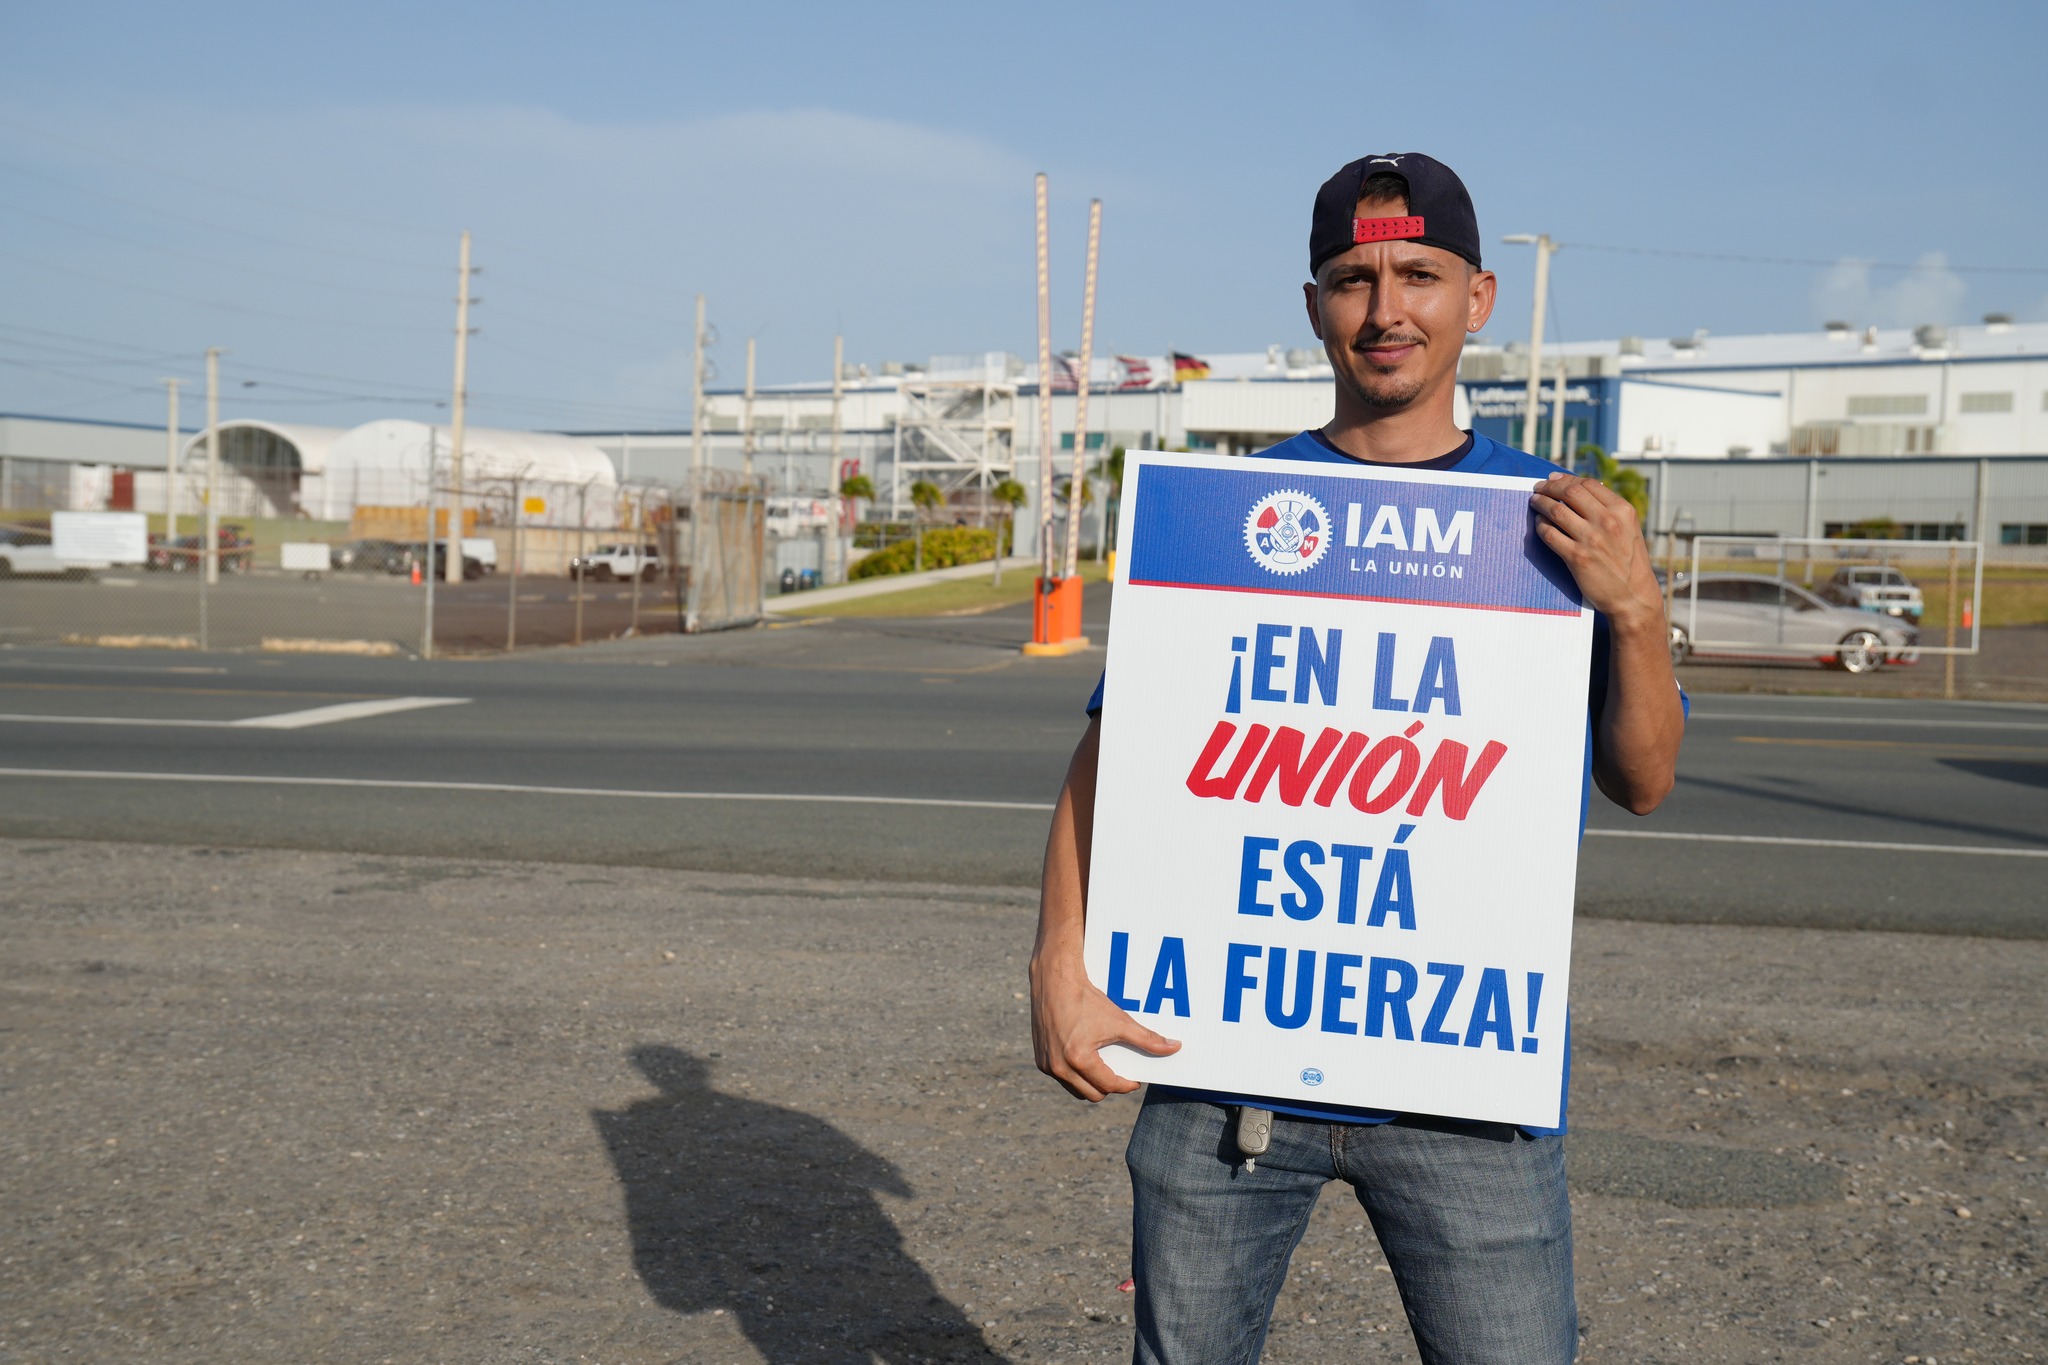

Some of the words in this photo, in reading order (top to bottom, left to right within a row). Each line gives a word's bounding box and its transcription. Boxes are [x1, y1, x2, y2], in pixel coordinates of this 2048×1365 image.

[1260, 536, 1270, 548] A
[1303, 539, 1314, 551] M
[1345, 502, 1475, 557] IAM
[1350, 558, 1378, 573] LA
[1389, 560, 1464, 579] UNIÓN
[1225, 623, 1343, 715] ¡EN
[1372, 632, 1462, 717] LA
[1186, 719, 1508, 821] UNIÓN
[1237, 823, 1417, 931] ESTÁ
[1106, 931, 1191, 1019] LA
[1222, 942, 1545, 1055] FUERZA!
